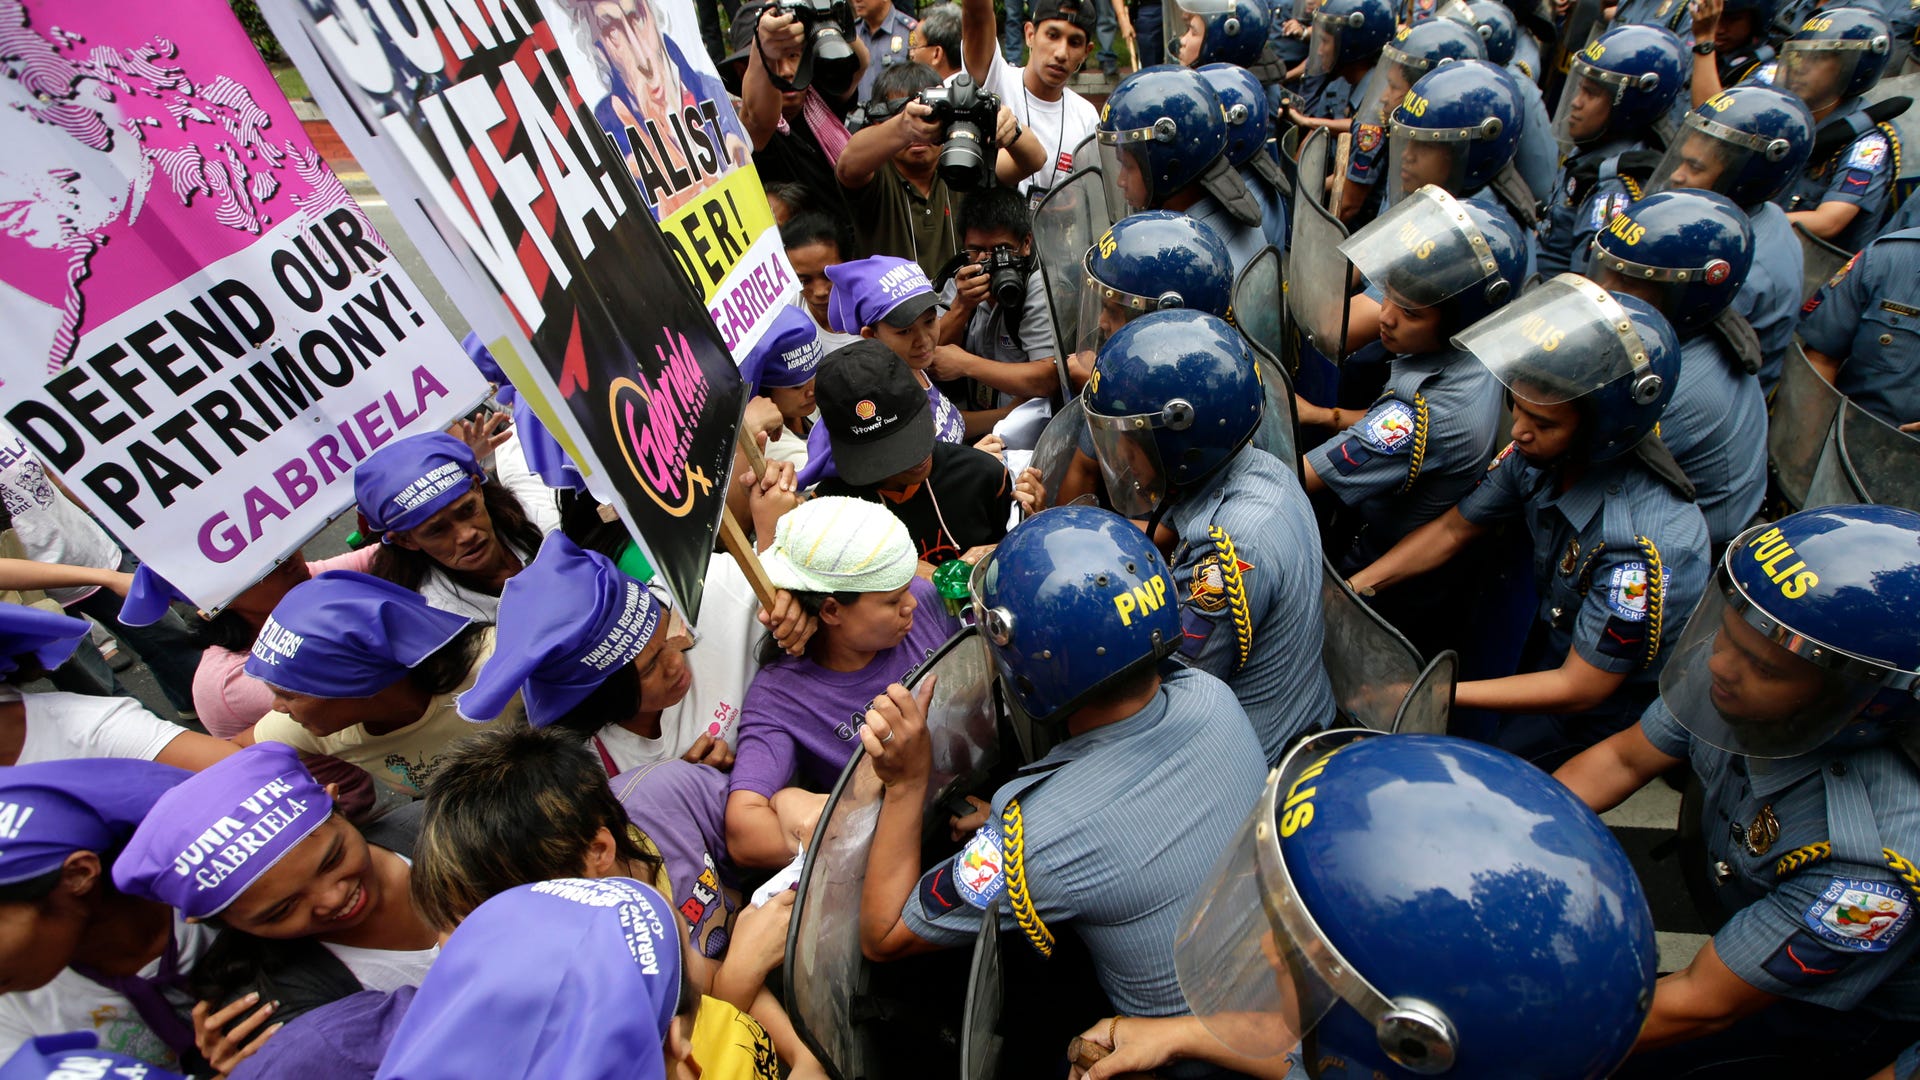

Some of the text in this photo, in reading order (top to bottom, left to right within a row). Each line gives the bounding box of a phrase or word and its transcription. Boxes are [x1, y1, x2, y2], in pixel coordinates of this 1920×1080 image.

[607, 99, 732, 206] ALIST
[380, 48, 627, 334] VFA!
[711, 252, 791, 351] GABRIELA
[879, 265, 914, 293] JUNK
[4, 208, 389, 474] DEFEND OUR
[82, 274, 425, 530] PATRIMONY!
[625, 326, 704, 499] Gabriela
[197, 365, 449, 563] GABRIELA
[393, 483, 418, 507] TUNAY
[414, 477, 430, 490] NA
[1749, 527, 1819, 599] PULIS
[1113, 574, 1166, 626] PNP
[1617, 606, 1646, 620] NCRP
[263, 621, 304, 659] TILLERS!
[581, 639, 612, 666] TUNAY
[608, 627, 624, 643] NA
[596, 634, 633, 670] AGRARYO
[714, 701, 731, 722] 54
[629, 904, 659, 974] AGRARYO
